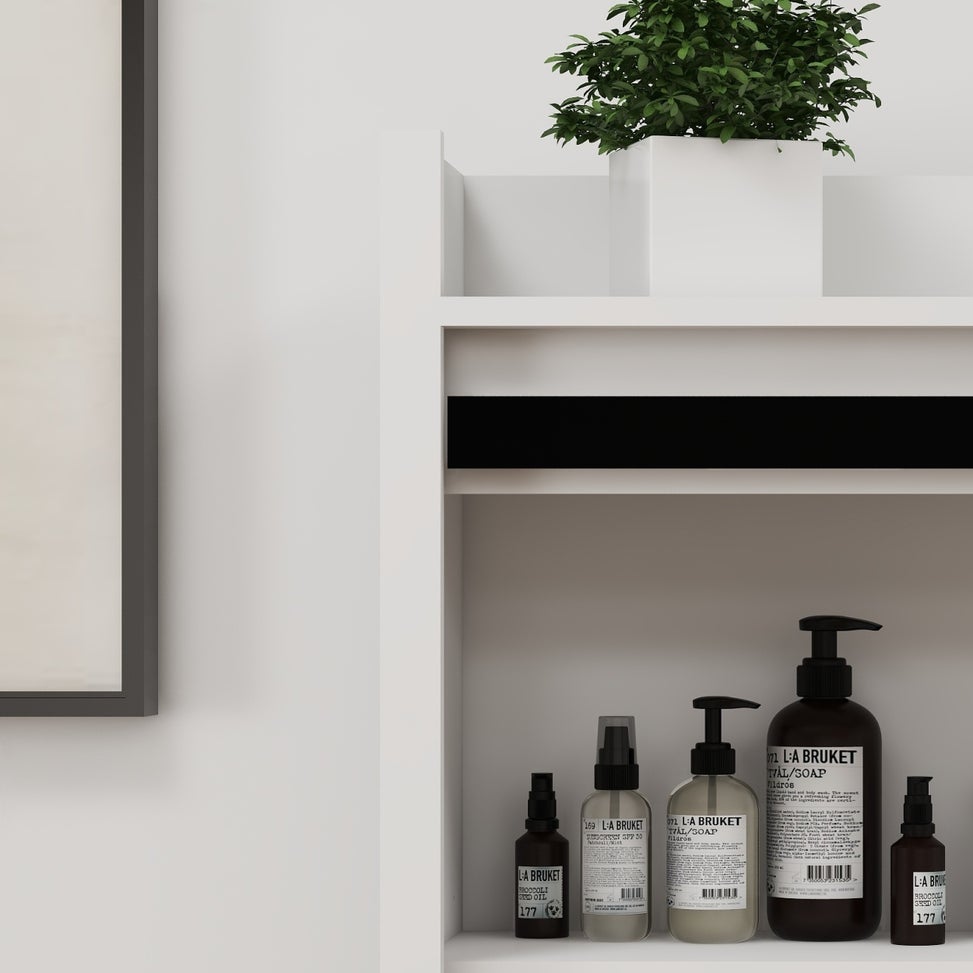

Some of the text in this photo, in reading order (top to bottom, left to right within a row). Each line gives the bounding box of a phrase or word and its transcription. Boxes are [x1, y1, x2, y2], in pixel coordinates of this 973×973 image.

[783, 749, 800, 764] L:A
[803, 749, 857, 764] BRUKET
[584, 820, 643, 830] 169 L:A BRUKET
[682, 817, 696, 825] L:A
[698, 817, 742, 826] BRUKET
[530, 870, 560, 881] BRUKET
[914, 876, 928, 887] L:A
[520, 906, 537, 917] 177
[917, 913, 936, 923] 177
